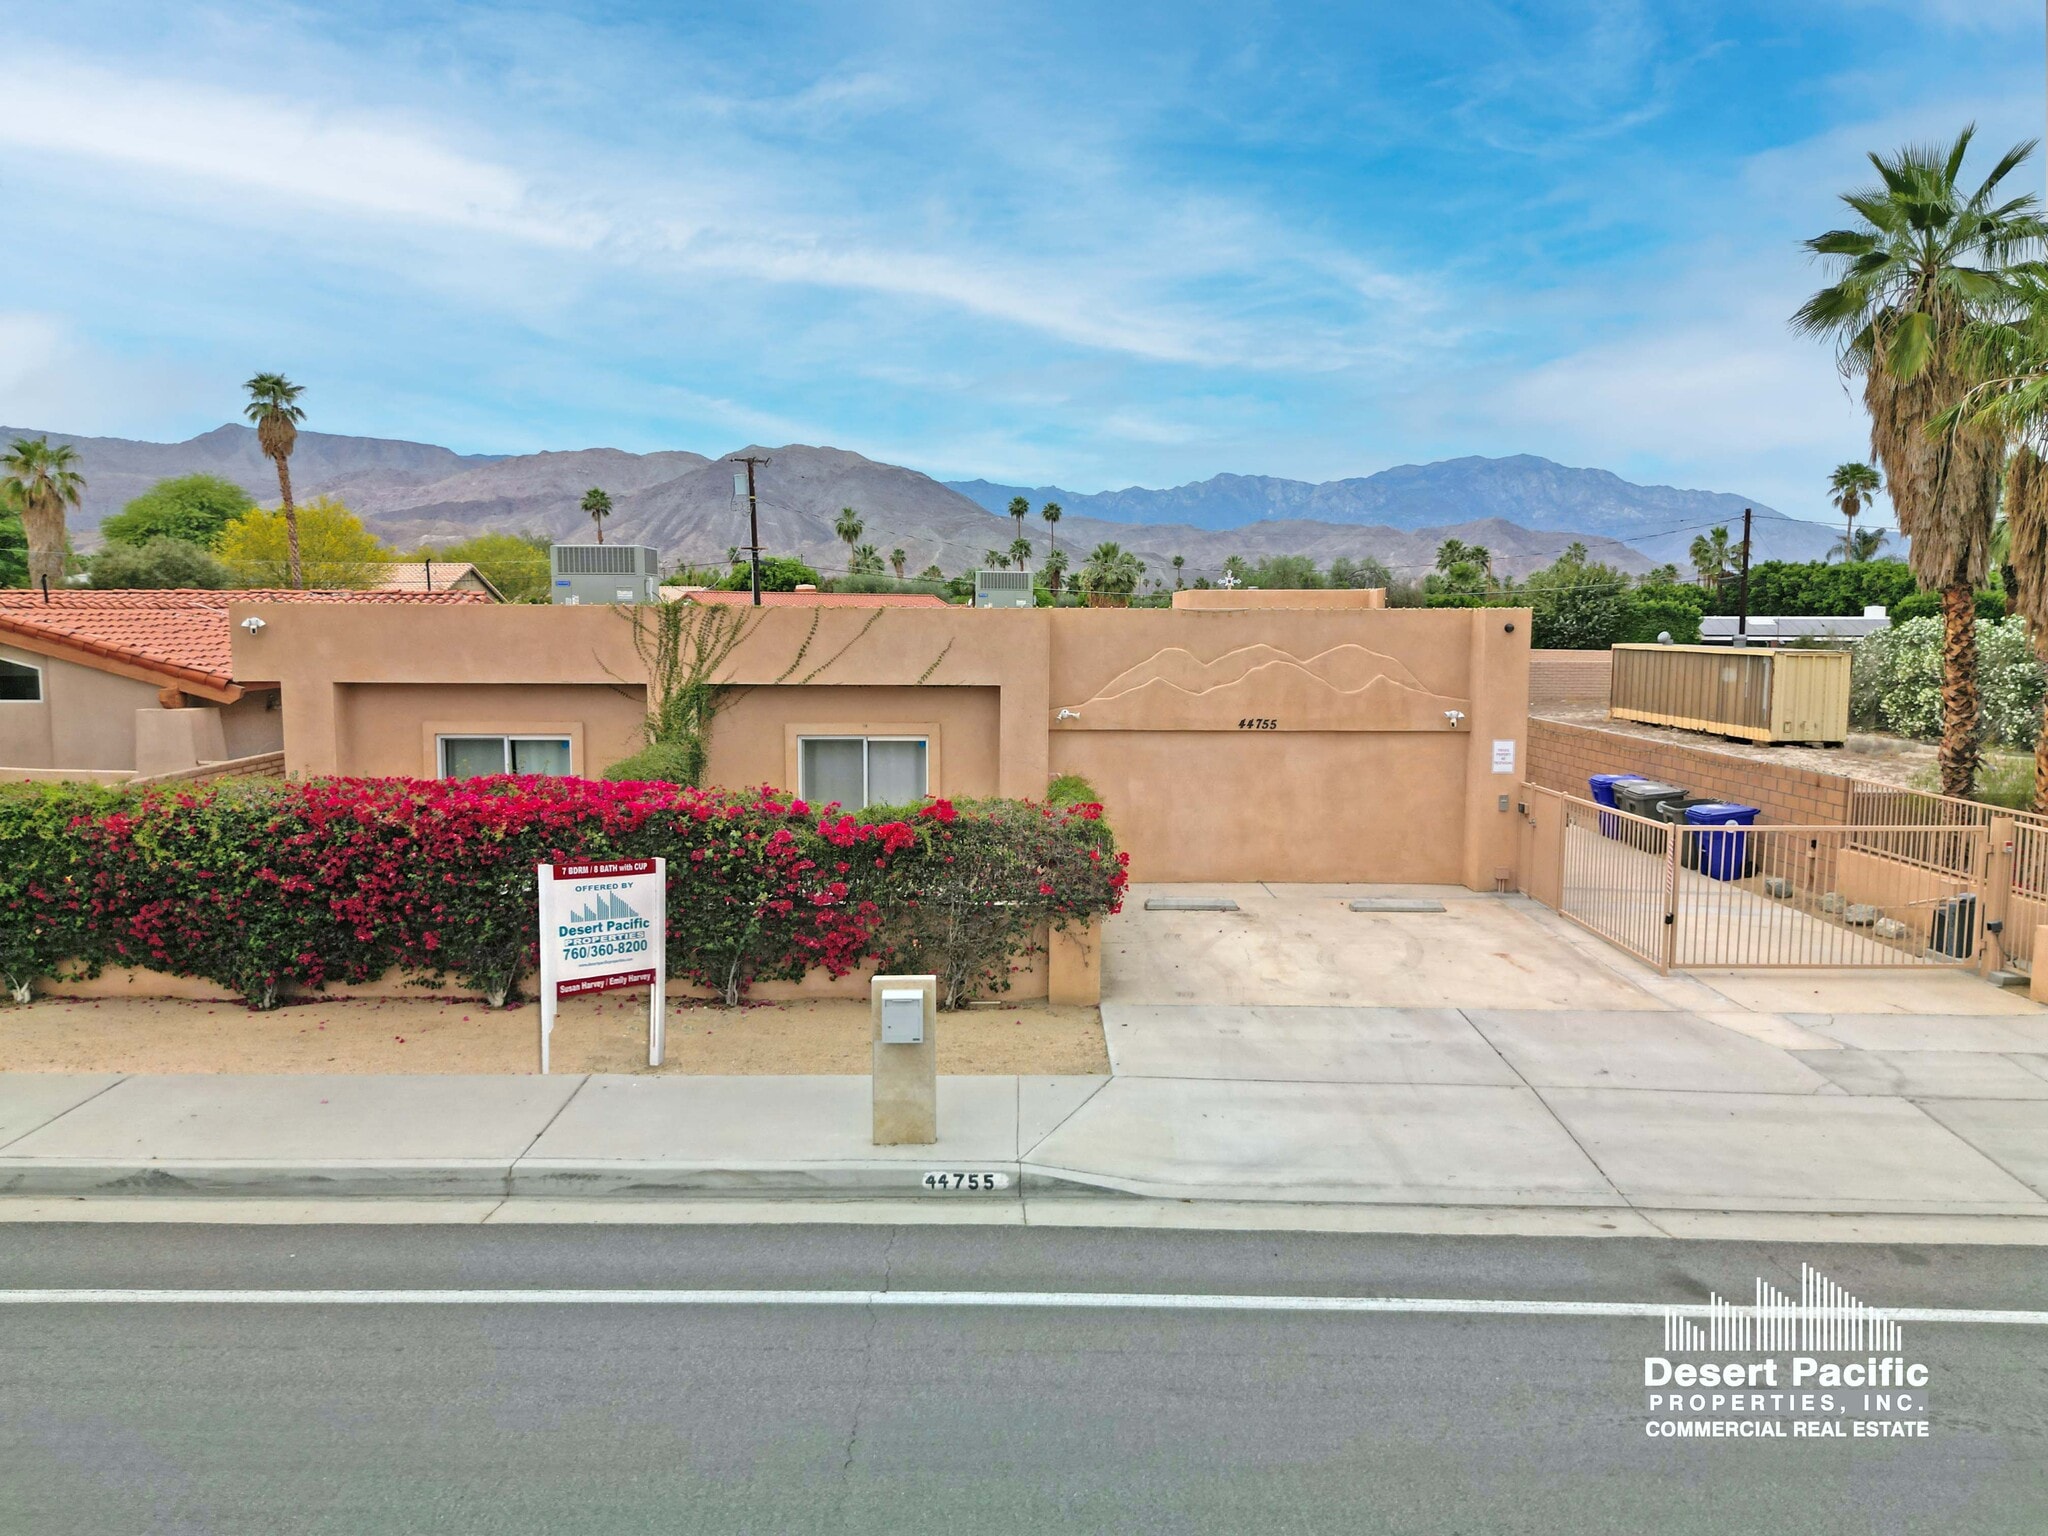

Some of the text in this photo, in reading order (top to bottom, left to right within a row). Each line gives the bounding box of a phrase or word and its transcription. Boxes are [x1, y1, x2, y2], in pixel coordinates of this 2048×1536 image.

[1238, 718, 1277, 729] 44755
[561, 867, 567, 875] 7
[568, 866, 589, 875] BDRM
[599, 864, 618, 873] BATH
[618, 863, 633, 872] with
[634, 862, 648, 871] CUP
[575, 881, 634, 892] OFFERED BY
[559, 917, 650, 937] Desert Pacific
[565, 931, 645, 946] PROPERTIES
[563, 939, 648, 960] 760/360-8200
[559, 983, 581, 993] Susan
[581, 980, 605, 989] Harvey
[609, 976, 627, 985] Emily
[628, 973, 651, 982] Harvey
[925, 1173, 994, 1190] 44755
